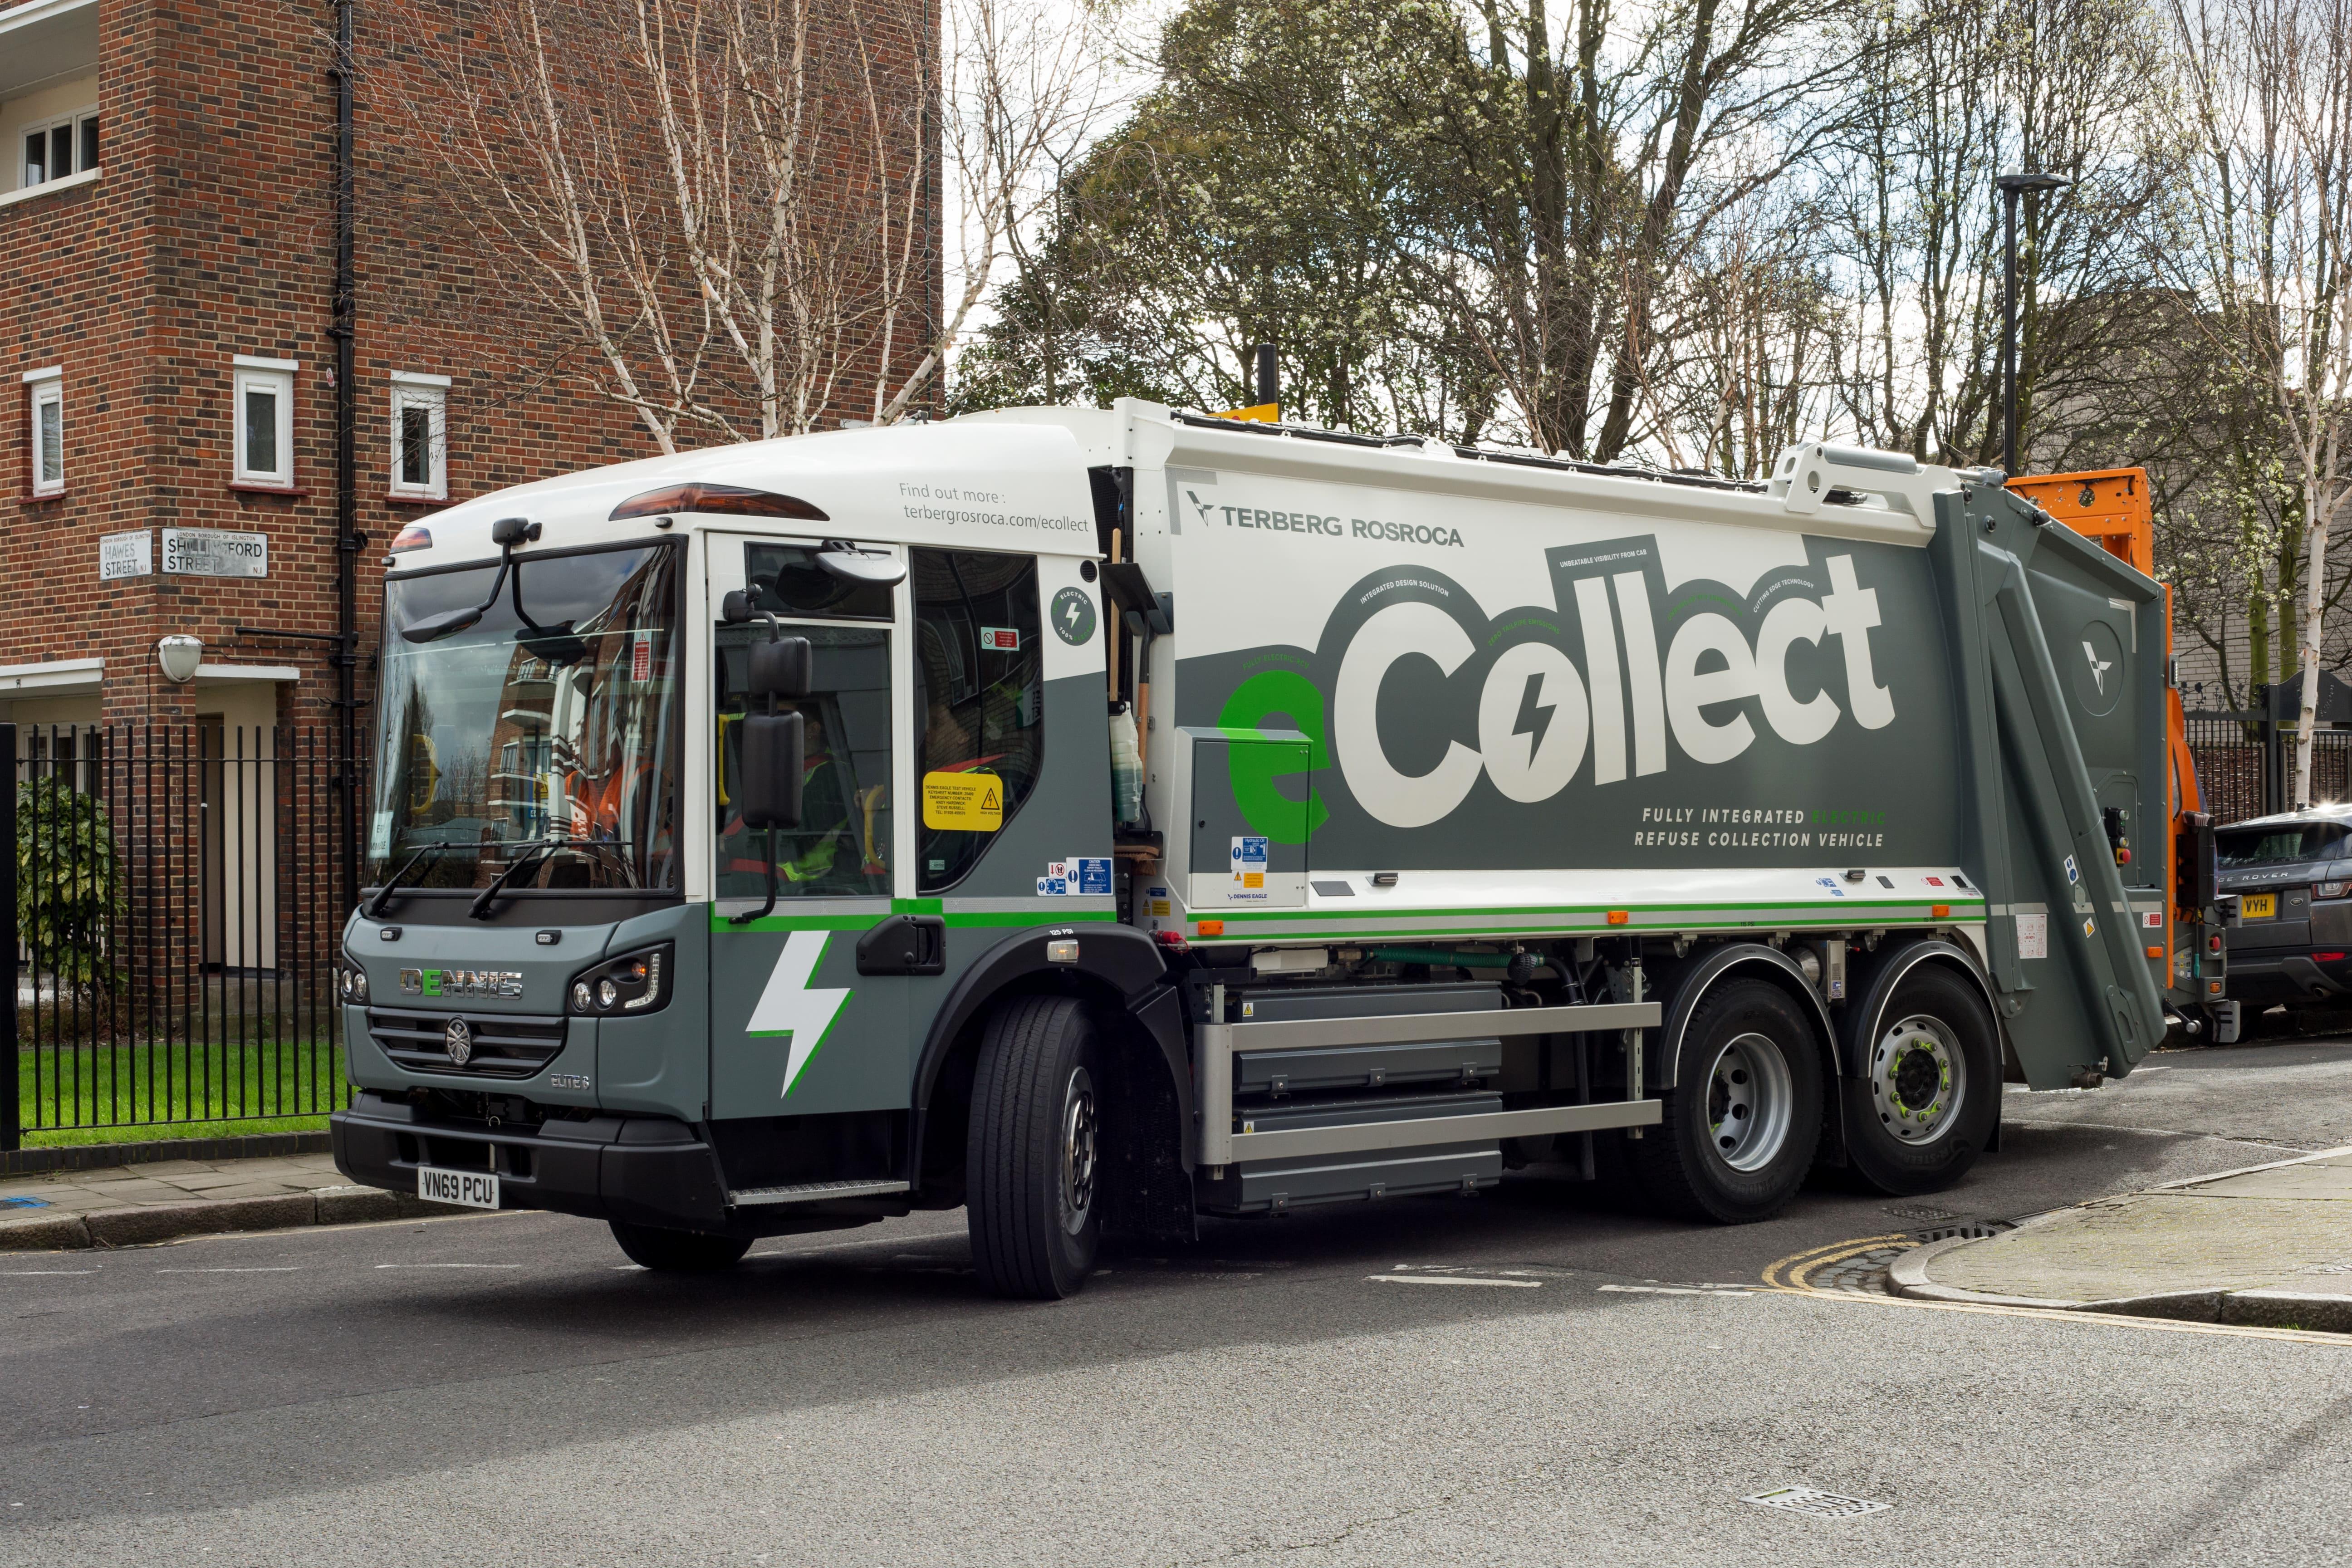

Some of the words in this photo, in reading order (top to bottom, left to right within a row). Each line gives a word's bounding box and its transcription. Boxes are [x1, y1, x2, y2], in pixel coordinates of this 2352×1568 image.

[899, 483, 930, 498] Find
[935, 487, 960, 500] out
[903, 504, 1089, 532] terbergrosroca.com/ecollect
[1219, 506, 1343, 536] TERBERG
[1351, 519, 1465, 548] ROSROCA
[105, 543, 135, 560] HAWES
[1560, 557, 1594, 568] UNBEATABLE
[1594, 553, 1619, 563] VISIBILITY
[1621, 550, 1635, 559] FROM
[106, 559, 137, 576] STREET
[168, 555, 220, 572] STREET
[1060, 591, 1088, 605] ELECTRIC
[1360, 582, 1394, 604] INTEGRATED
[1419, 580, 1449, 597] SOLUTION
[1753, 590, 1769, 613] CUTTING
[1769, 582, 1781, 593] EDGE
[1781, 578, 1814, 589] TECHNOLOGY
[1059, 627, 1073, 640] 100%
[1503, 619, 1527, 632] TAILPIPE
[1528, 617, 1560, 635] EMISSIONS
[1643, 808, 1694, 822] FULLY
[1702, 808, 1804, 824] INTEGRATED
[1811, 810, 1886, 825] ELECTRIC
[1634, 832, 1700, 846] REFUSE
[1708, 832, 1810, 847] COLLECTION
[1819, 833, 1883, 847] VEHICLE
[2242, 872, 2289, 881] ROVER
[2246, 899, 2268, 912] VYH
[400, 968, 522, 1000] DENNIS
[551, 1073, 581, 1089] ELITE
[582, 1076, 589, 1089] 6
[424, 1171, 459, 1200] VN69
[463, 1176, 492, 1204] PCU
